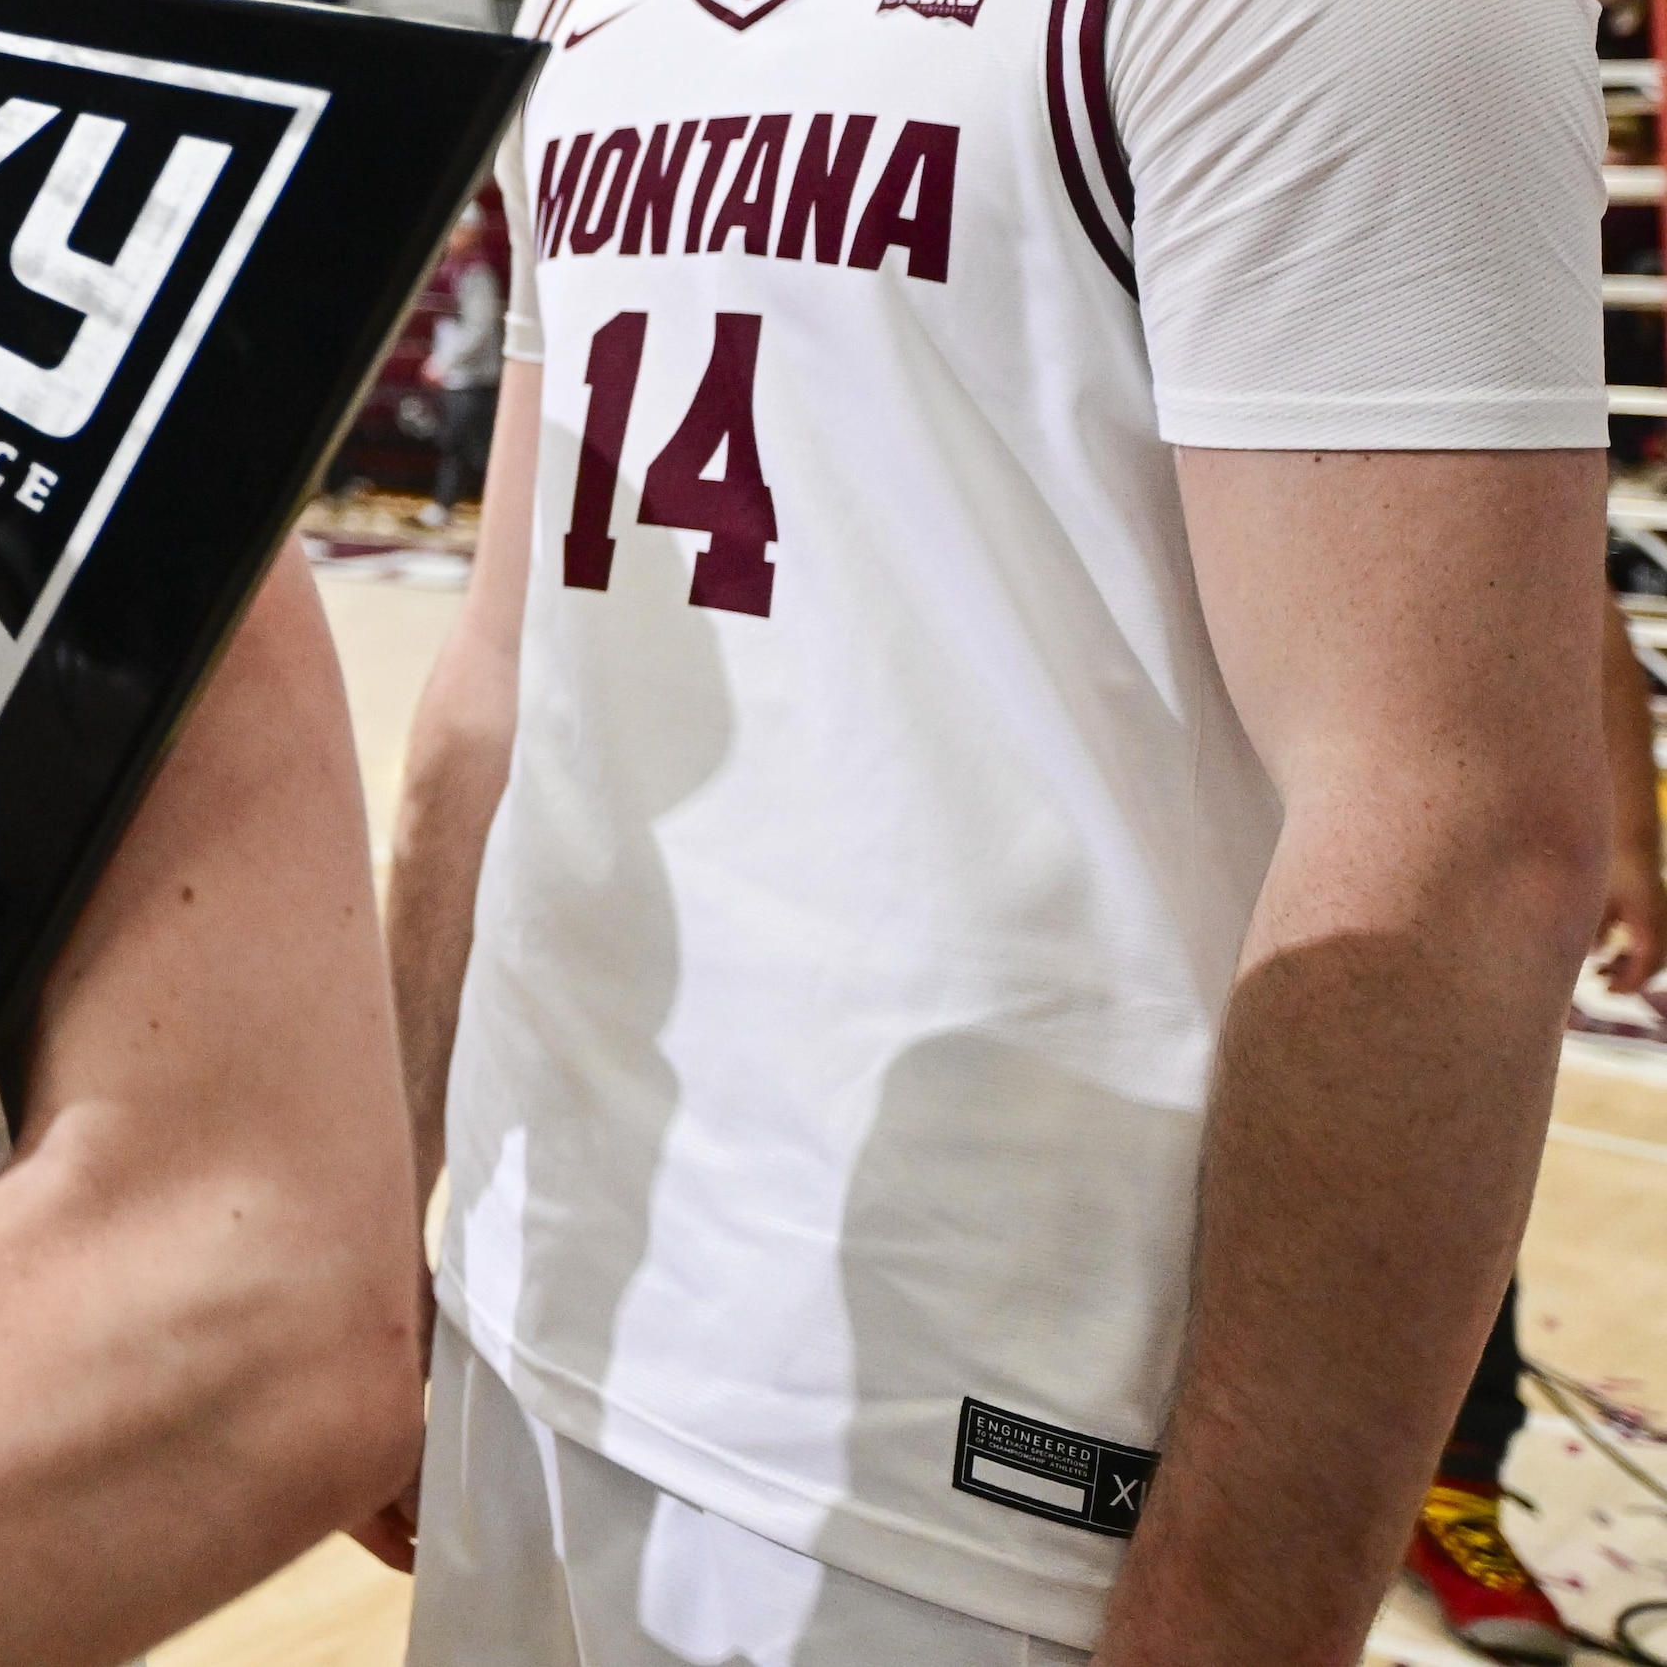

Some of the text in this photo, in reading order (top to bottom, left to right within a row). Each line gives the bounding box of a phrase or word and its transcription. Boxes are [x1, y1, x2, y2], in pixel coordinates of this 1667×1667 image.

[537, 112, 961, 284] MONTANA
[561, 311, 779, 619] 14
[976, 1415, 1091, 1462] ENGINEERED
[976, 1428, 1089, 1471] TO THE EXACT SPECIFICATIONS
[988, 1441, 1047, 1465] CHAMPIONSHIP
[1049, 1461, 1089, 1477] ATHLETES
